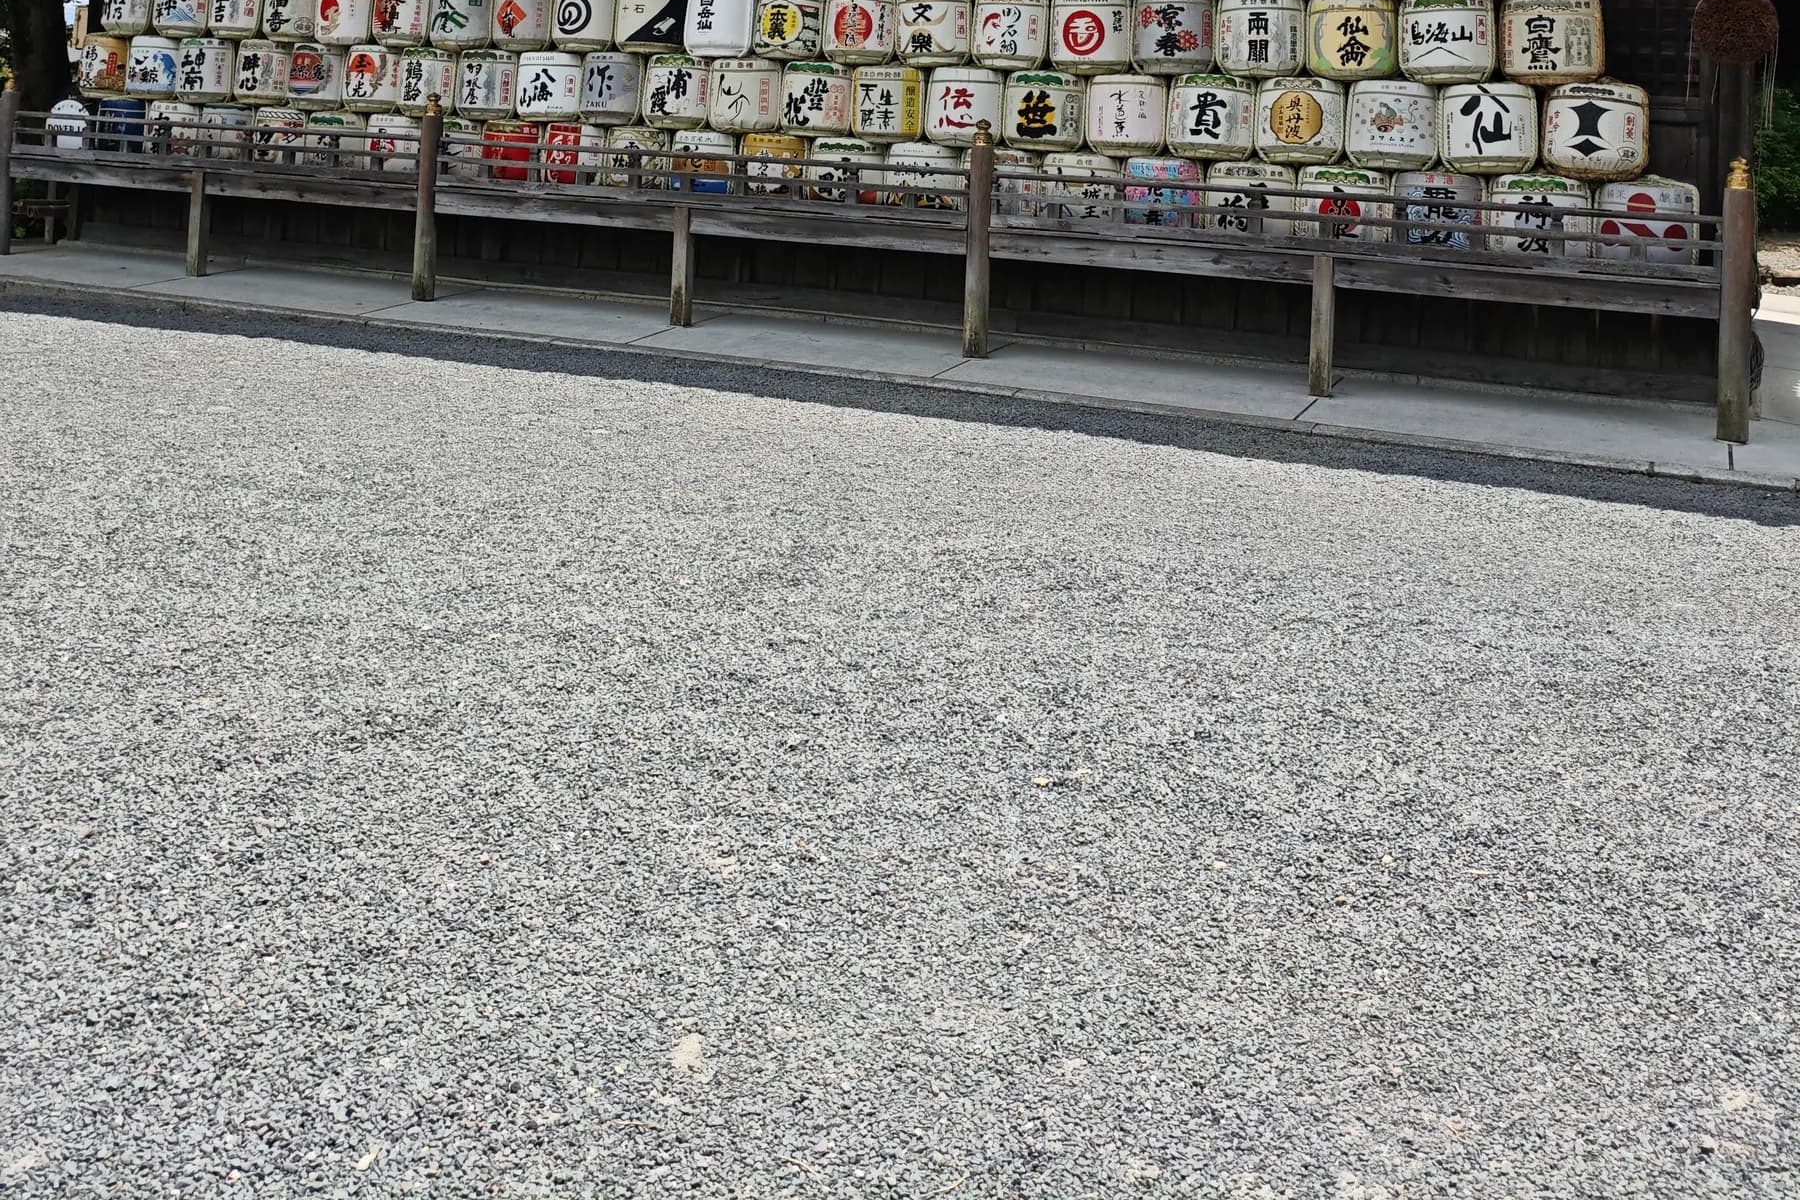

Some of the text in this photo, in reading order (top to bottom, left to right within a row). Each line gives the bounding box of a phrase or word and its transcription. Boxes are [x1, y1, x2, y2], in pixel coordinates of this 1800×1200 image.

[622, 3, 646, 14] 十石
[767, 4, 790, 41] 一本義
[1336, 16, 1371, 67] 仙禽
[1409, 20, 1473, 46] 鳥海山
[1521, 14, 1562, 71] 白鷹
[520, 68, 557, 108] 八海山
[586, 65, 613, 98] 作
[650, 68, 692, 115] 浦霞
[939, 86, 977, 128] 伝心
[1189, 91, 1228, 140] 貴
[1285, 94, 1305, 140] 奥丹波
[1425, 175, 1455, 184] 清酒
